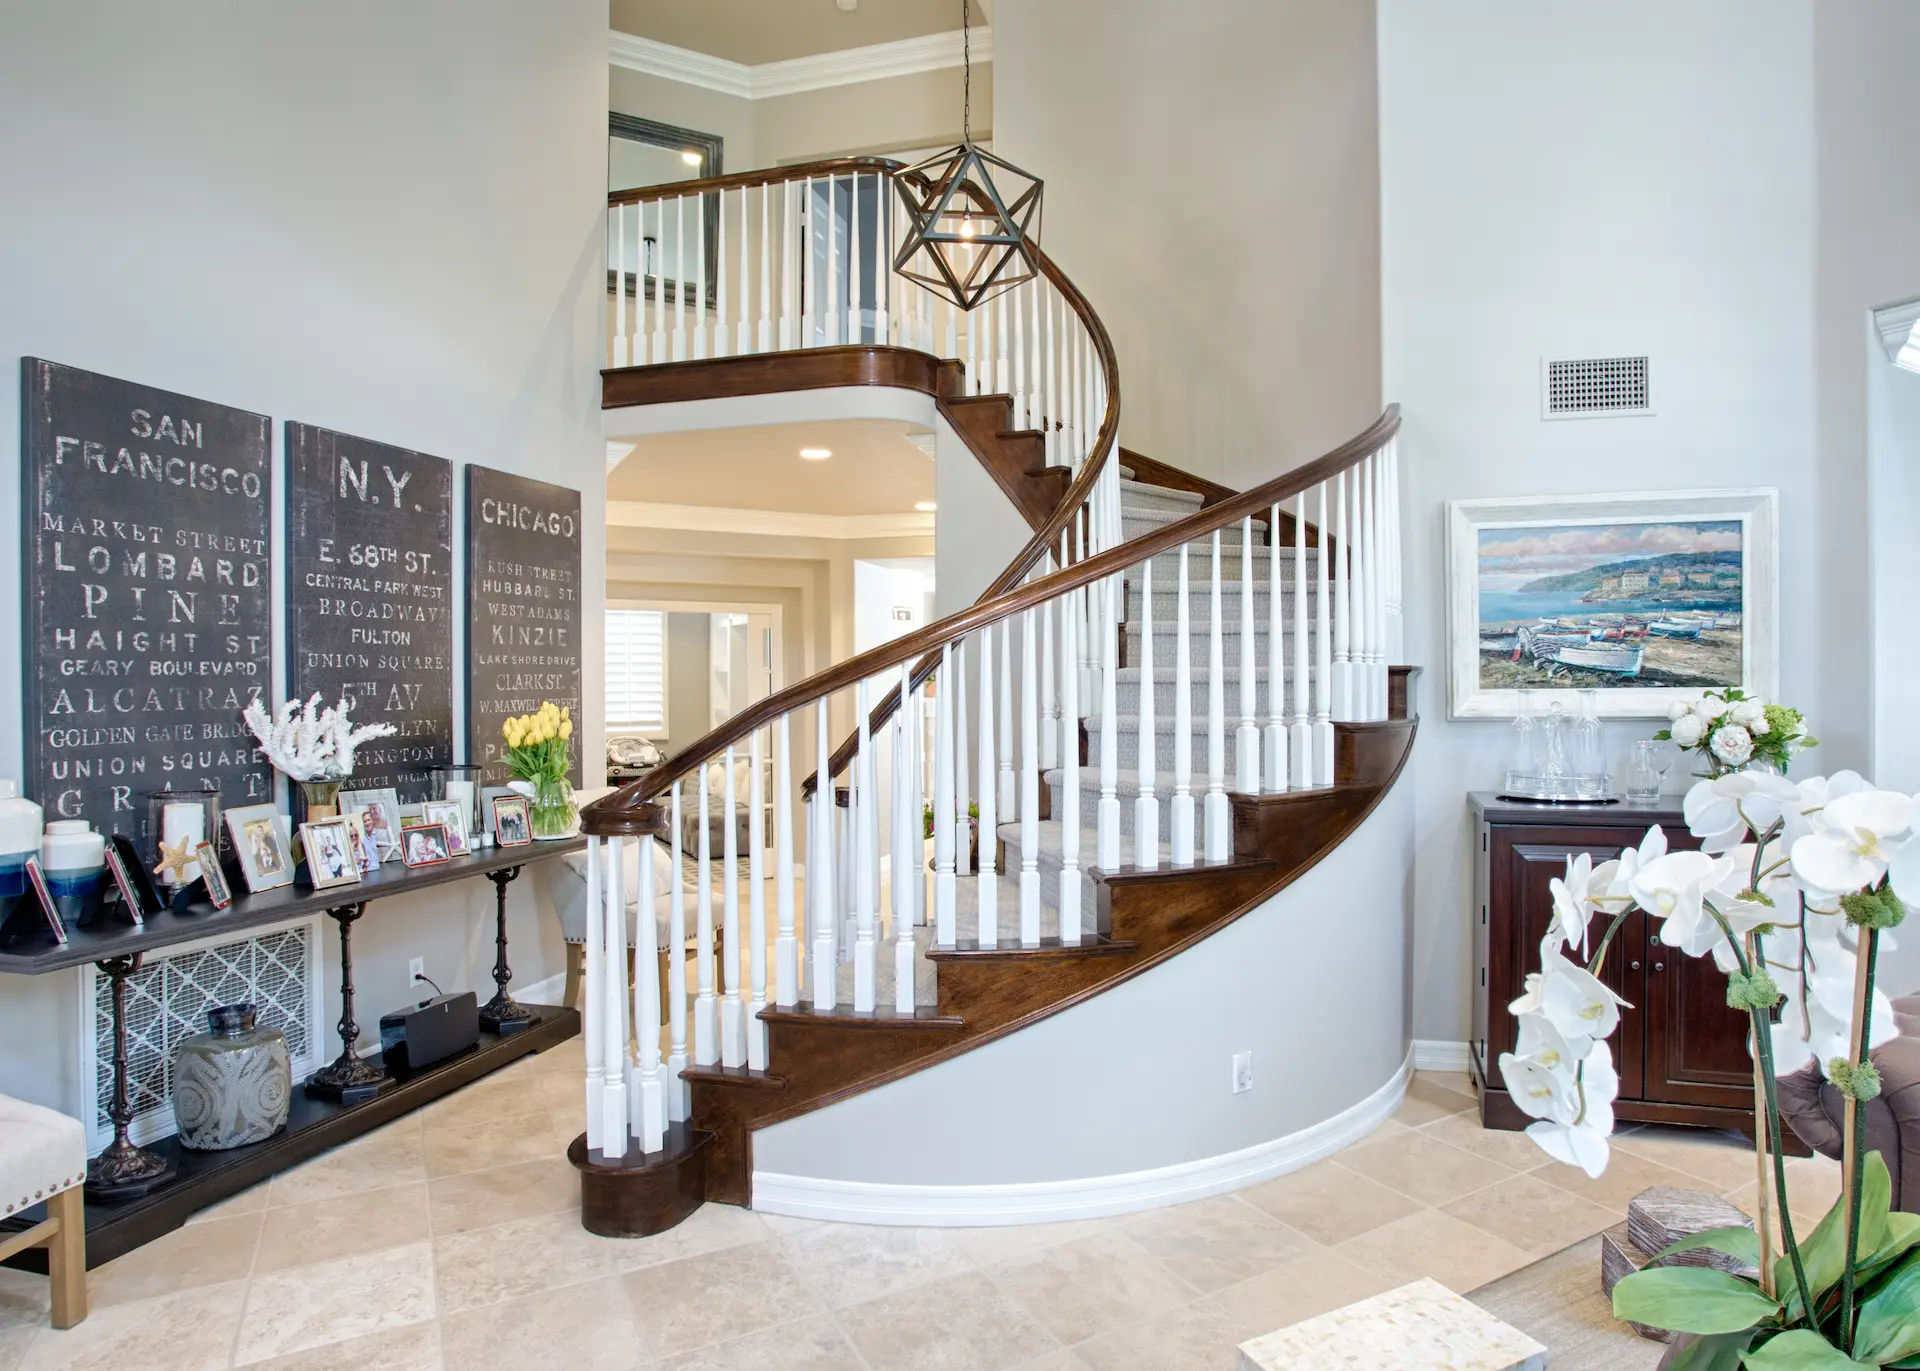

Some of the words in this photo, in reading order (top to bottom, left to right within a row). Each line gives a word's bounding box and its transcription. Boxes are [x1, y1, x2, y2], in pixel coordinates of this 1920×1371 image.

[130, 408, 203, 449] SAN
[55, 435, 262, 499] FRANCISCO
[339, 455, 423, 513] N.Y.
[481, 498, 575, 538] CHICAGO
[42, 512, 163, 544] MARKET
[175, 529, 266, 556] STREET
[54, 541, 260, 588] LOMBARD
[318, 538, 341, 563] E.
[348, 543, 397, 568] 68TH
[404, 550, 437, 576] ST.
[488, 560, 523, 577] RUSH
[527, 565, 572, 583] STREET
[305, 573, 371, 592] CENTRAL
[374, 580, 409, 596] PARK
[412, 584, 443, 599] WEST
[558, 587, 576, 601] ST.
[80, 583, 242, 626] PINE
[318, 598, 438, 622] BROADWAY
[488, 602, 526, 617] WEST
[527, 606, 571, 621] ADAMS
[54, 628, 198, 653] HAIGHT
[225, 635, 261, 655] ST
[351, 628, 411, 646] FULTON
[492, 625, 568, 647] KINZIE
[60, 659, 135, 676] GEARY
[149, 660, 258, 677] BOULEVARD
[307, 652, 370, 669] UNION
[377, 655, 444, 671] SQUARE
[479, 655, 508, 665] LAKE
[511, 655, 545, 666] SHORE
[547, 656, 577, 666] DRIVE
[496, 673, 544, 692] CLARK
[545, 673, 566, 691] ST.
[49, 686, 263, 715] ALCATRAZ
[341, 682, 377, 712] 5TH
[384, 683, 423, 711] AV
[479, 700, 493, 714] W.
[494, 699, 543, 713] MAXWELL
[49, 726, 136, 748] GOLDEN
[145, 723, 194, 743] GATE
[201, 721, 253, 740] BRIDG
[52, 755, 146, 780] UNION
[161, 748, 264, 771] SQUARE
[353, 746, 435, 767] XINGTON
